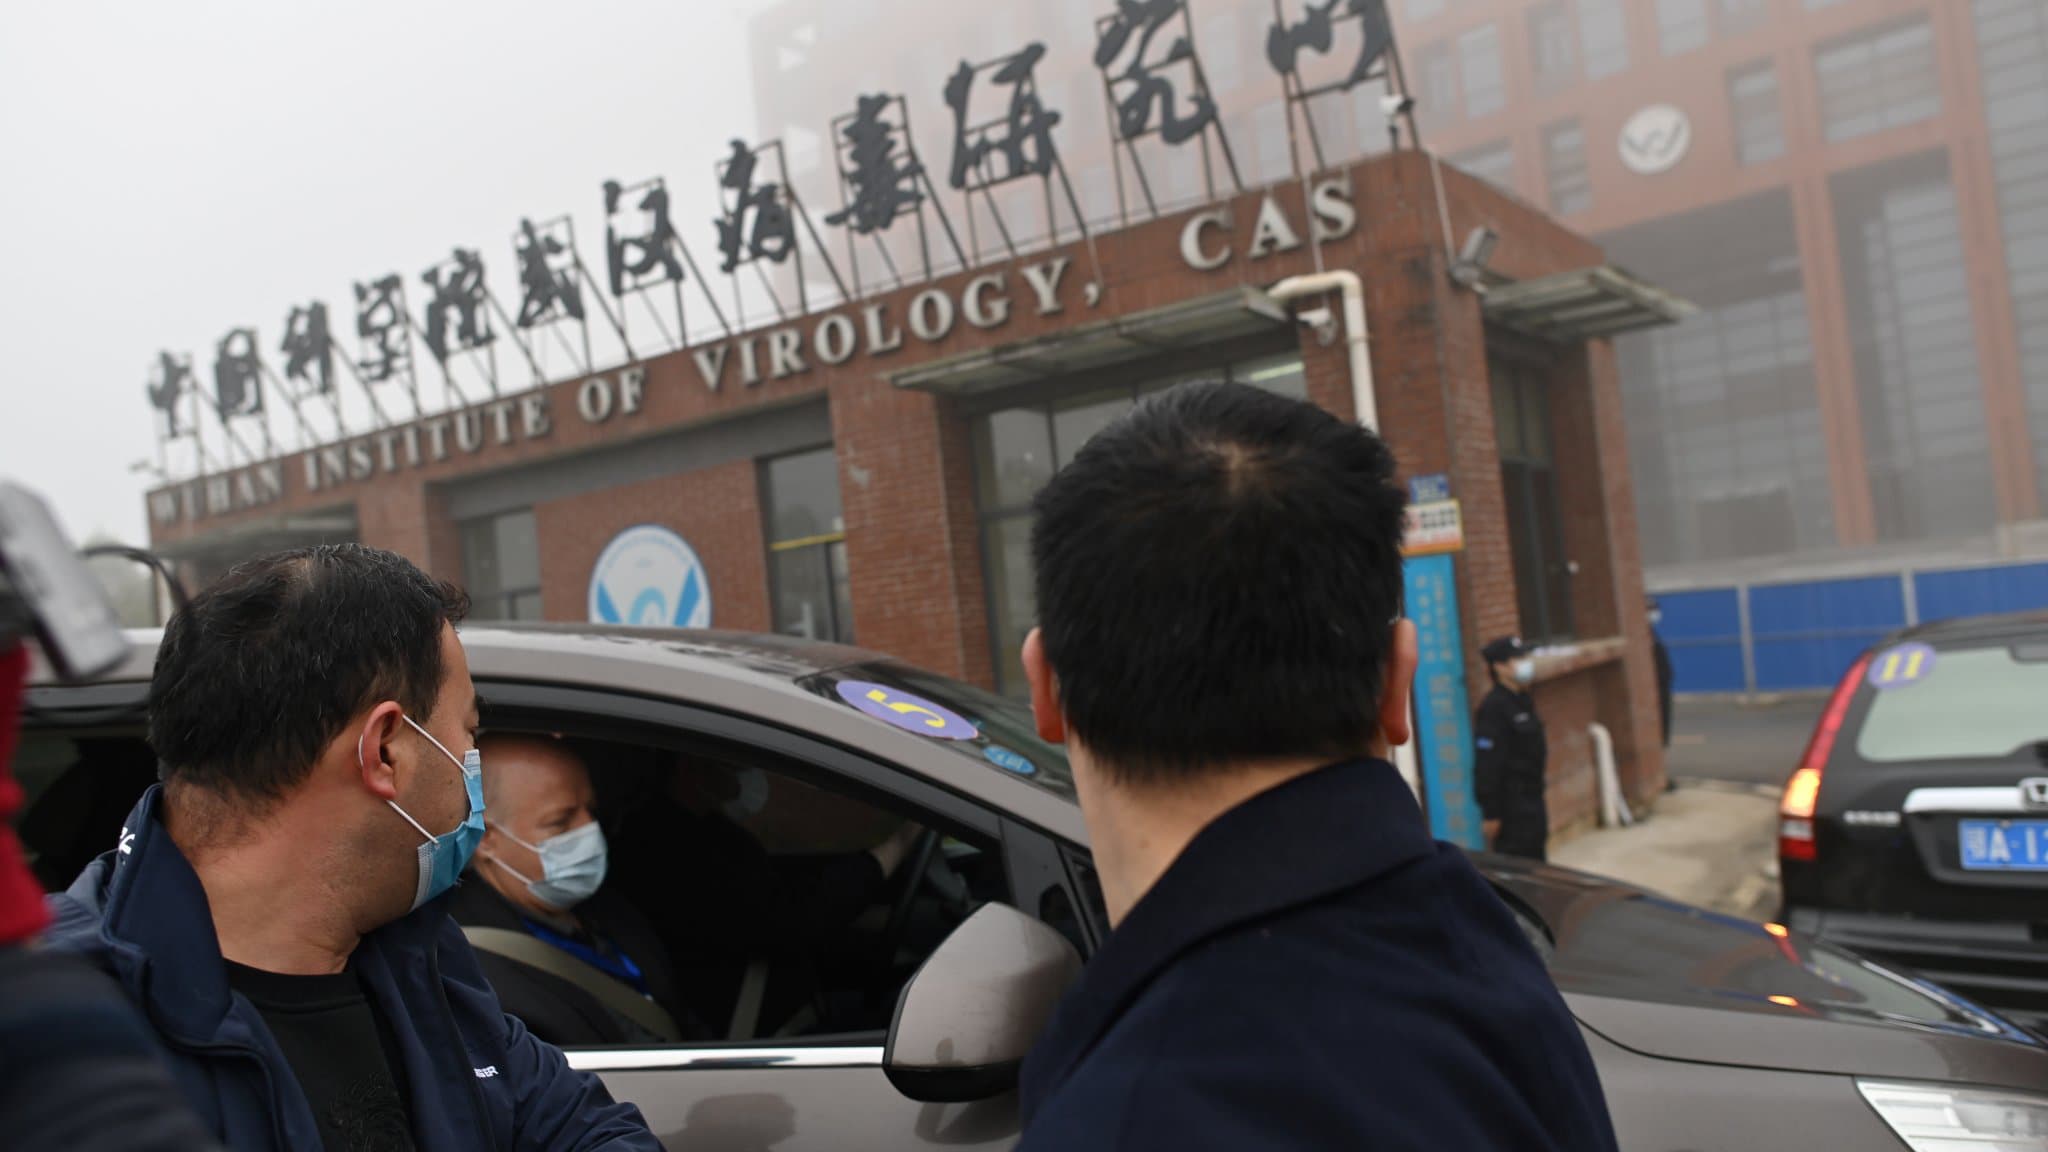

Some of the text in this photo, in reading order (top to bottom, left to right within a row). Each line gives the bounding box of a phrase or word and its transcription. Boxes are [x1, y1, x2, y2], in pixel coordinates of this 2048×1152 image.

[305, 395, 550, 492] INSTITUTE
[577, 365, 647, 424] OF
[694, 256, 1102, 393] VIROLOGY,
[1180, 170, 1356, 270] CAS
[865, 688, 946, 728] 5
